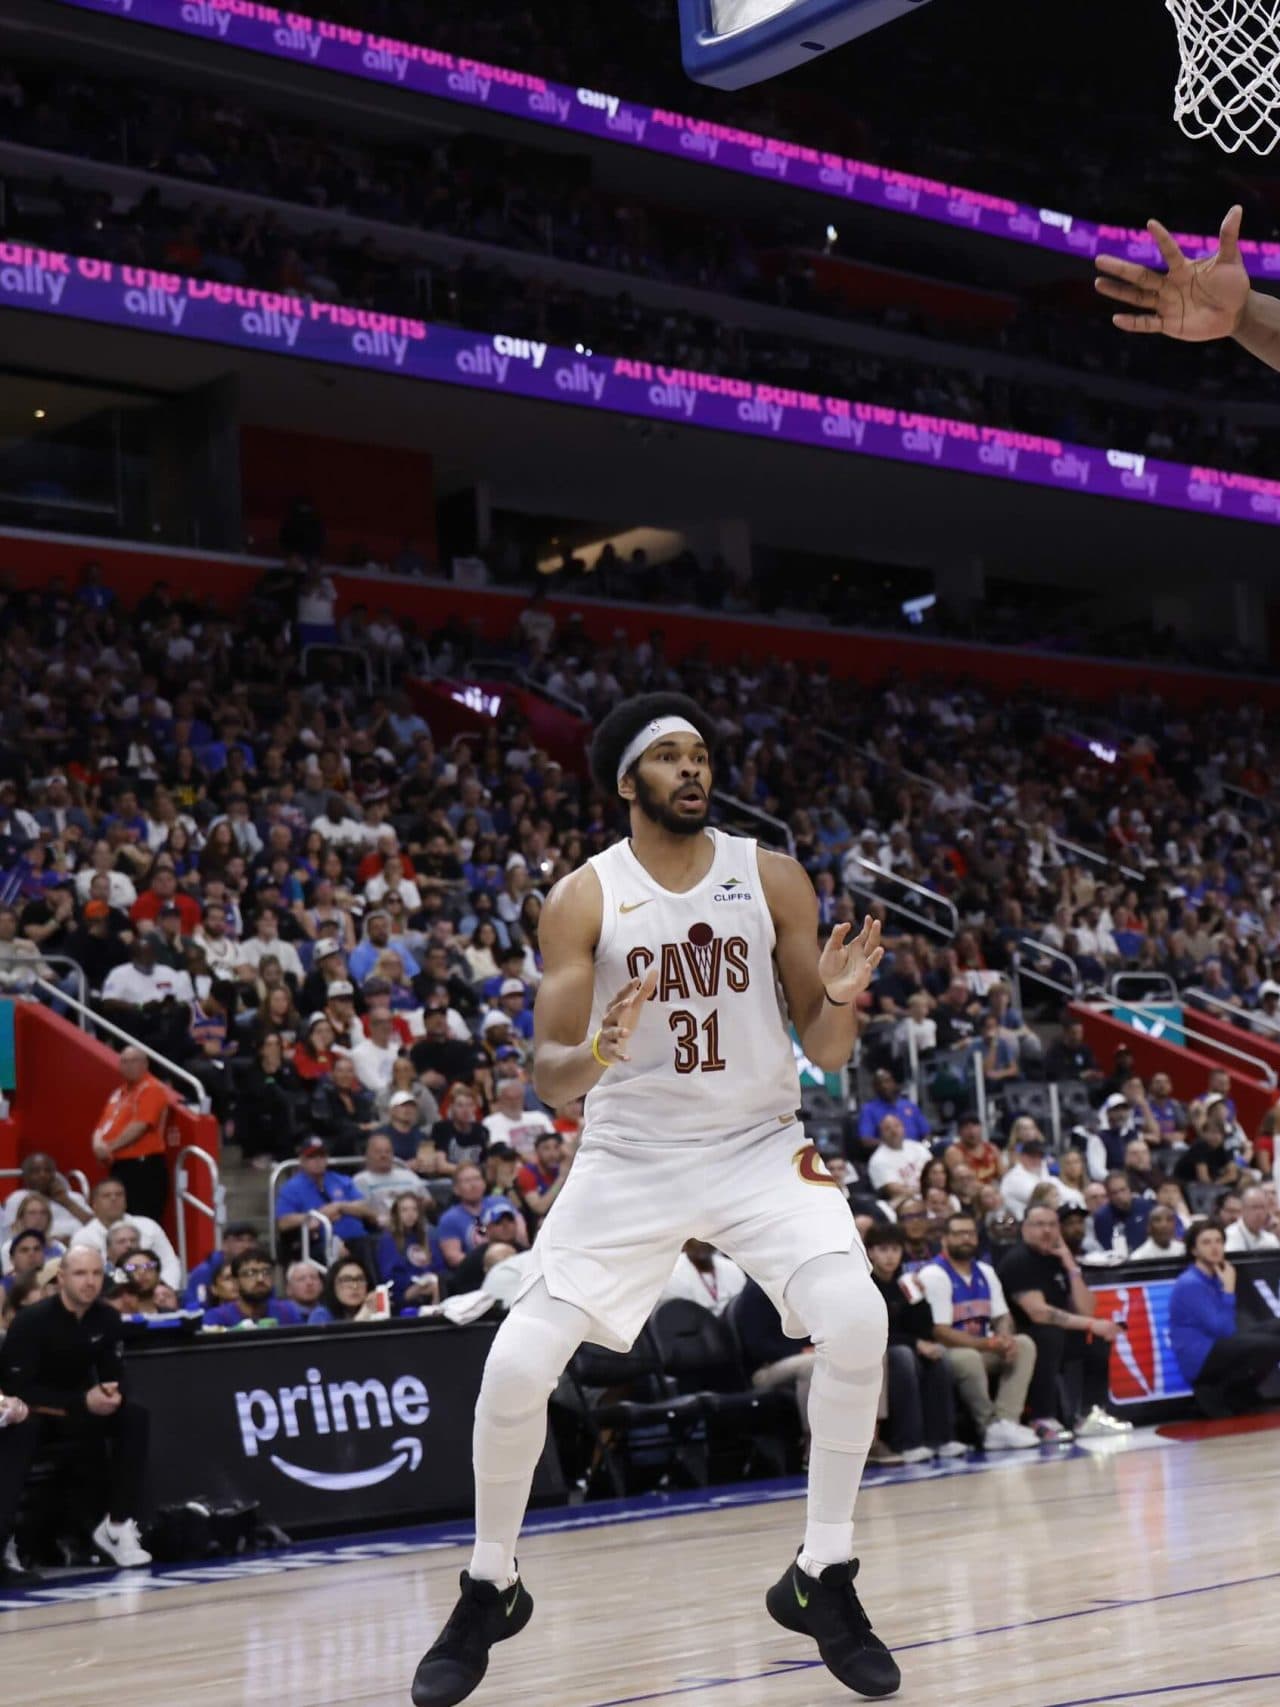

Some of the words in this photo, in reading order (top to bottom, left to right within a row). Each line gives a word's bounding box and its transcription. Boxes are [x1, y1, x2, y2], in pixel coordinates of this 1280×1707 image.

[273, 26, 322, 59] ally
[362, 48, 409, 81] ally
[447, 70, 492, 100] ally
[528, 90, 571, 121] ally
[0, 241, 71, 275] ank
[0, 264, 67, 306] ally
[123, 285, 188, 327] ally
[240, 308, 301, 347] ally
[352, 328, 409, 366] ally
[456, 345, 511, 384] ally
[493, 334, 548, 370] ally
[555, 362, 606, 401] ally
[648, 381, 697, 417] ally
[737, 395, 784, 432] ally
[821, 413, 866, 446] ally
[713, 892, 752, 902] CLIFFS
[626, 935, 751, 1002] CAVS
[668, 1008, 727, 1075] 31
[234, 1366, 431, 1457] prime
